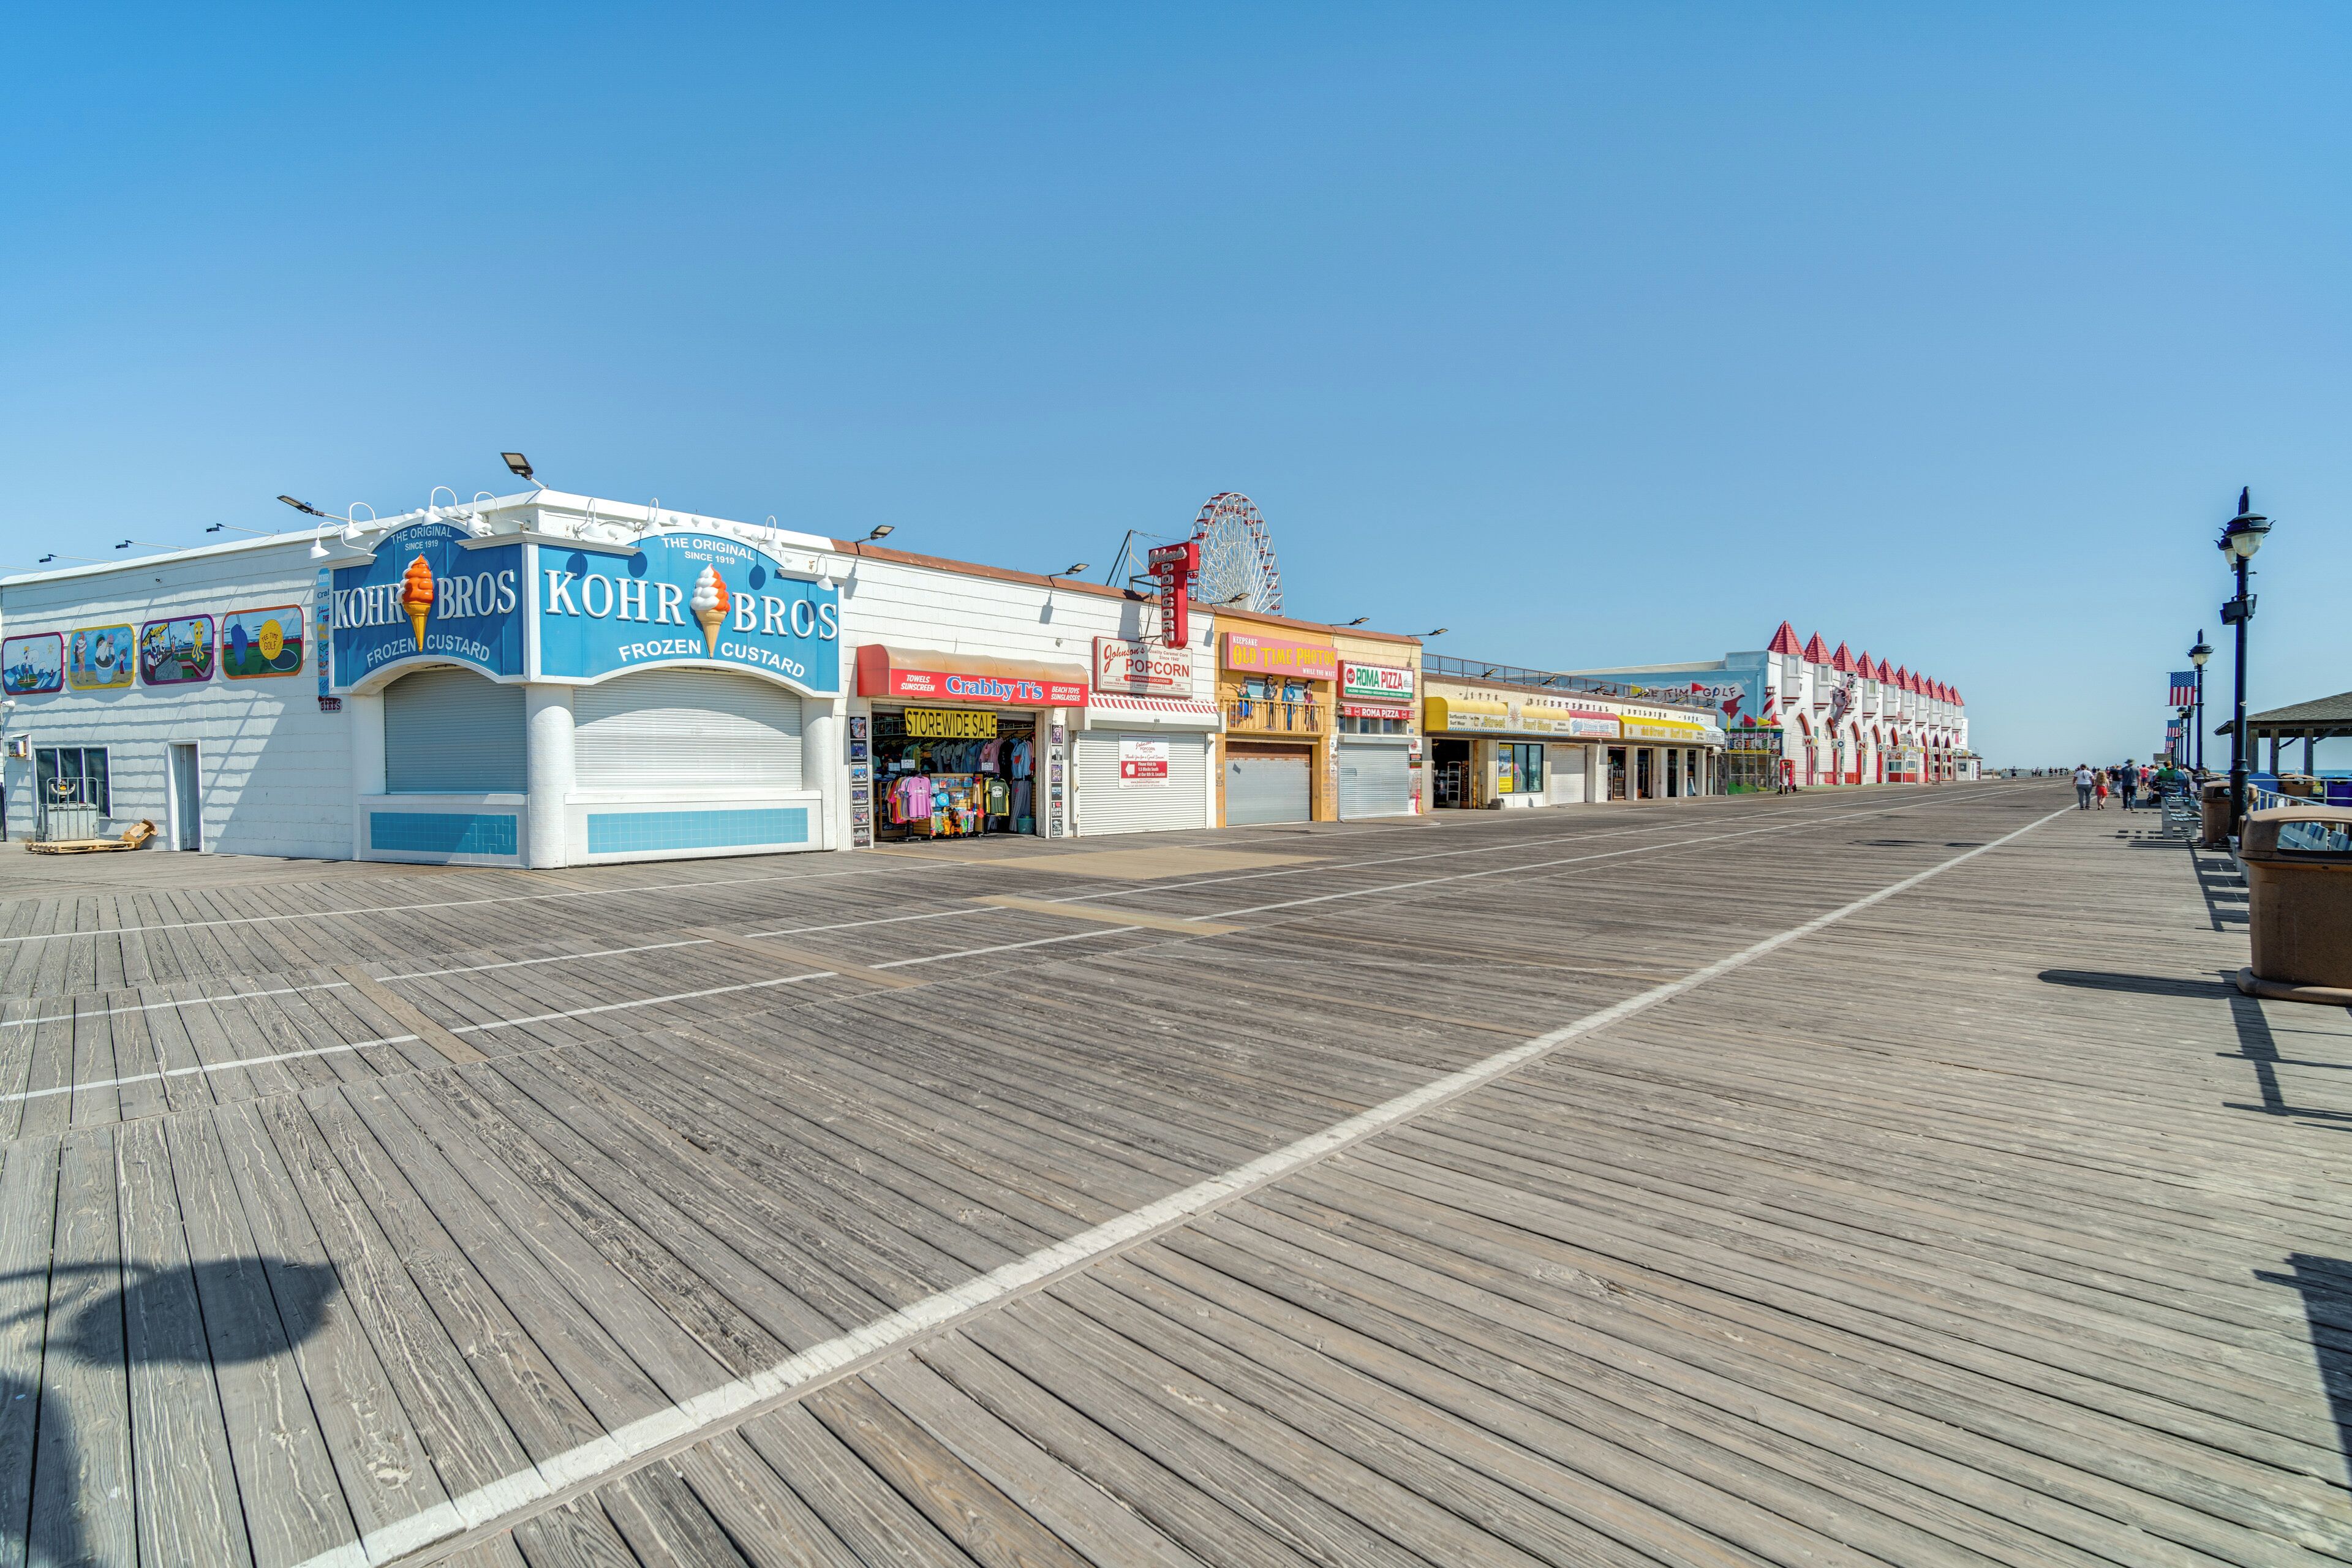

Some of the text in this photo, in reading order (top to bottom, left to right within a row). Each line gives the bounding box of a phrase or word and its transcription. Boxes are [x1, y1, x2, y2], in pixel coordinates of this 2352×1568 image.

[391, 526, 453, 545] THE ORIGINAL
[404, 539, 439, 551] SINCE 1919
[662, 537, 755, 562] THE ORIGINAL
[684, 551, 736, 565] SINCE 1919
[333, 568, 516, 630] KOHR BROS
[544, 569, 839, 641] KOHR BROS
[1161, 562, 1175, 642] POPCORN
[264, 641, 277, 650] GOLF
[1232, 635, 1258, 647] KEEPSAKE
[366, 635, 491, 668] FROZEN CUSTARD
[618, 639, 805, 679] FROZEN CUSTARD
[1104, 644, 1145, 674] Johnson's
[1233, 644, 1336, 667] OLD TIME PHOTOS
[1126, 658, 1189, 677] POPCORN
[900, 682, 935, 692] SUNSCREEN
[906, 674, 930, 684] TOWELS
[1356, 668, 1403, 690] ROMA PIZZA
[945, 676, 1044, 701] Crabby T's
[1050, 693, 1081, 702] SUNGLASSES
[1703, 687, 1736, 698] GOLF
[320, 700, 341, 710] BIKES
[1362, 707, 1381, 717] ROMA
[1382, 709, 1400, 718] PIZZA
[1529, 698, 1609, 712] BICENTENNIAL
[906, 710, 998, 738] STOREWIDE SALE
[1483, 716, 1506, 729] Street
[1523, 718, 1537, 731] Surf
[1537, 720, 1551, 733] Shop
[1649, 726, 1665, 737] Street
[1670, 728, 1680, 738] Surf
